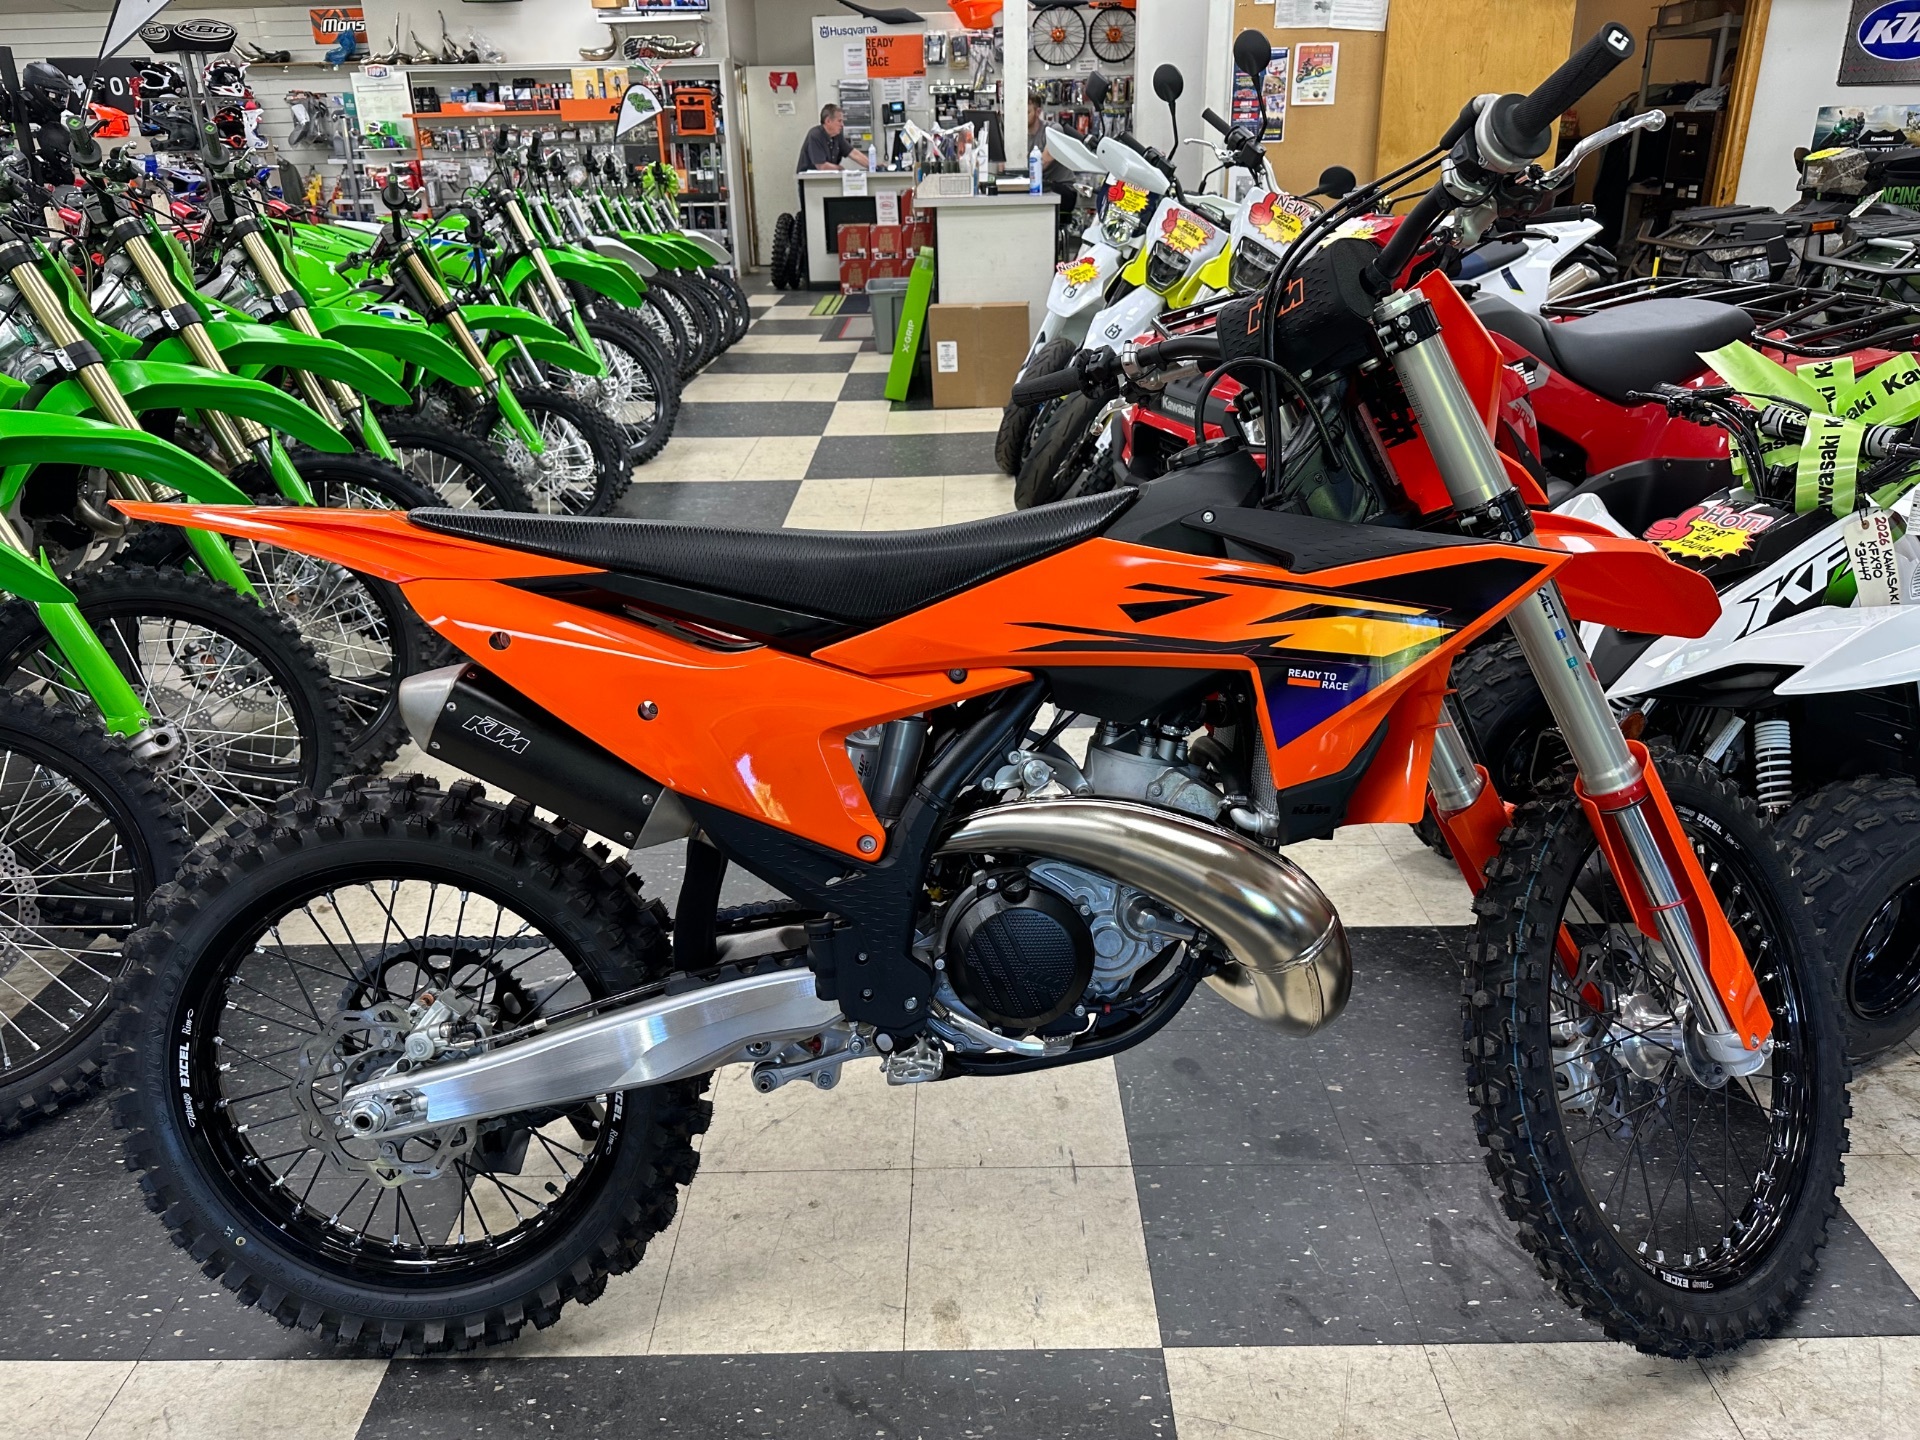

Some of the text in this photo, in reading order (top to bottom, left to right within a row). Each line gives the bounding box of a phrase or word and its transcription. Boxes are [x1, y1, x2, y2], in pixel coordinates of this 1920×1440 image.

[141, 27, 165, 36] KBC
[180, 25, 230, 34] KBC
[830, 26, 878, 36] Husqvarna
[866, 38, 894, 48] READY
[866, 48, 878, 57] TO
[866, 57, 889, 67] RACE
[301, 239, 330, 250] Kawasaki
[1162, 395, 1196, 420] Kawasak
[1702, 507, 1766, 532] HOT!
[1695, 525, 1736, 539] START
[1867, 540, 1883, 579] KFX90
[1874, 516, 1900, 605] 2026 KAWASAKI
[1288, 668, 1337, 681] READY TO
[1321, 681, 1349, 691] RACE
[462, 715, 531, 755] KTM
[1696, 813, 1722, 836] EXCEL
[179, 1042, 191, 1088] EXCEL
[1660, 1270, 1690, 1289] EXCEL
